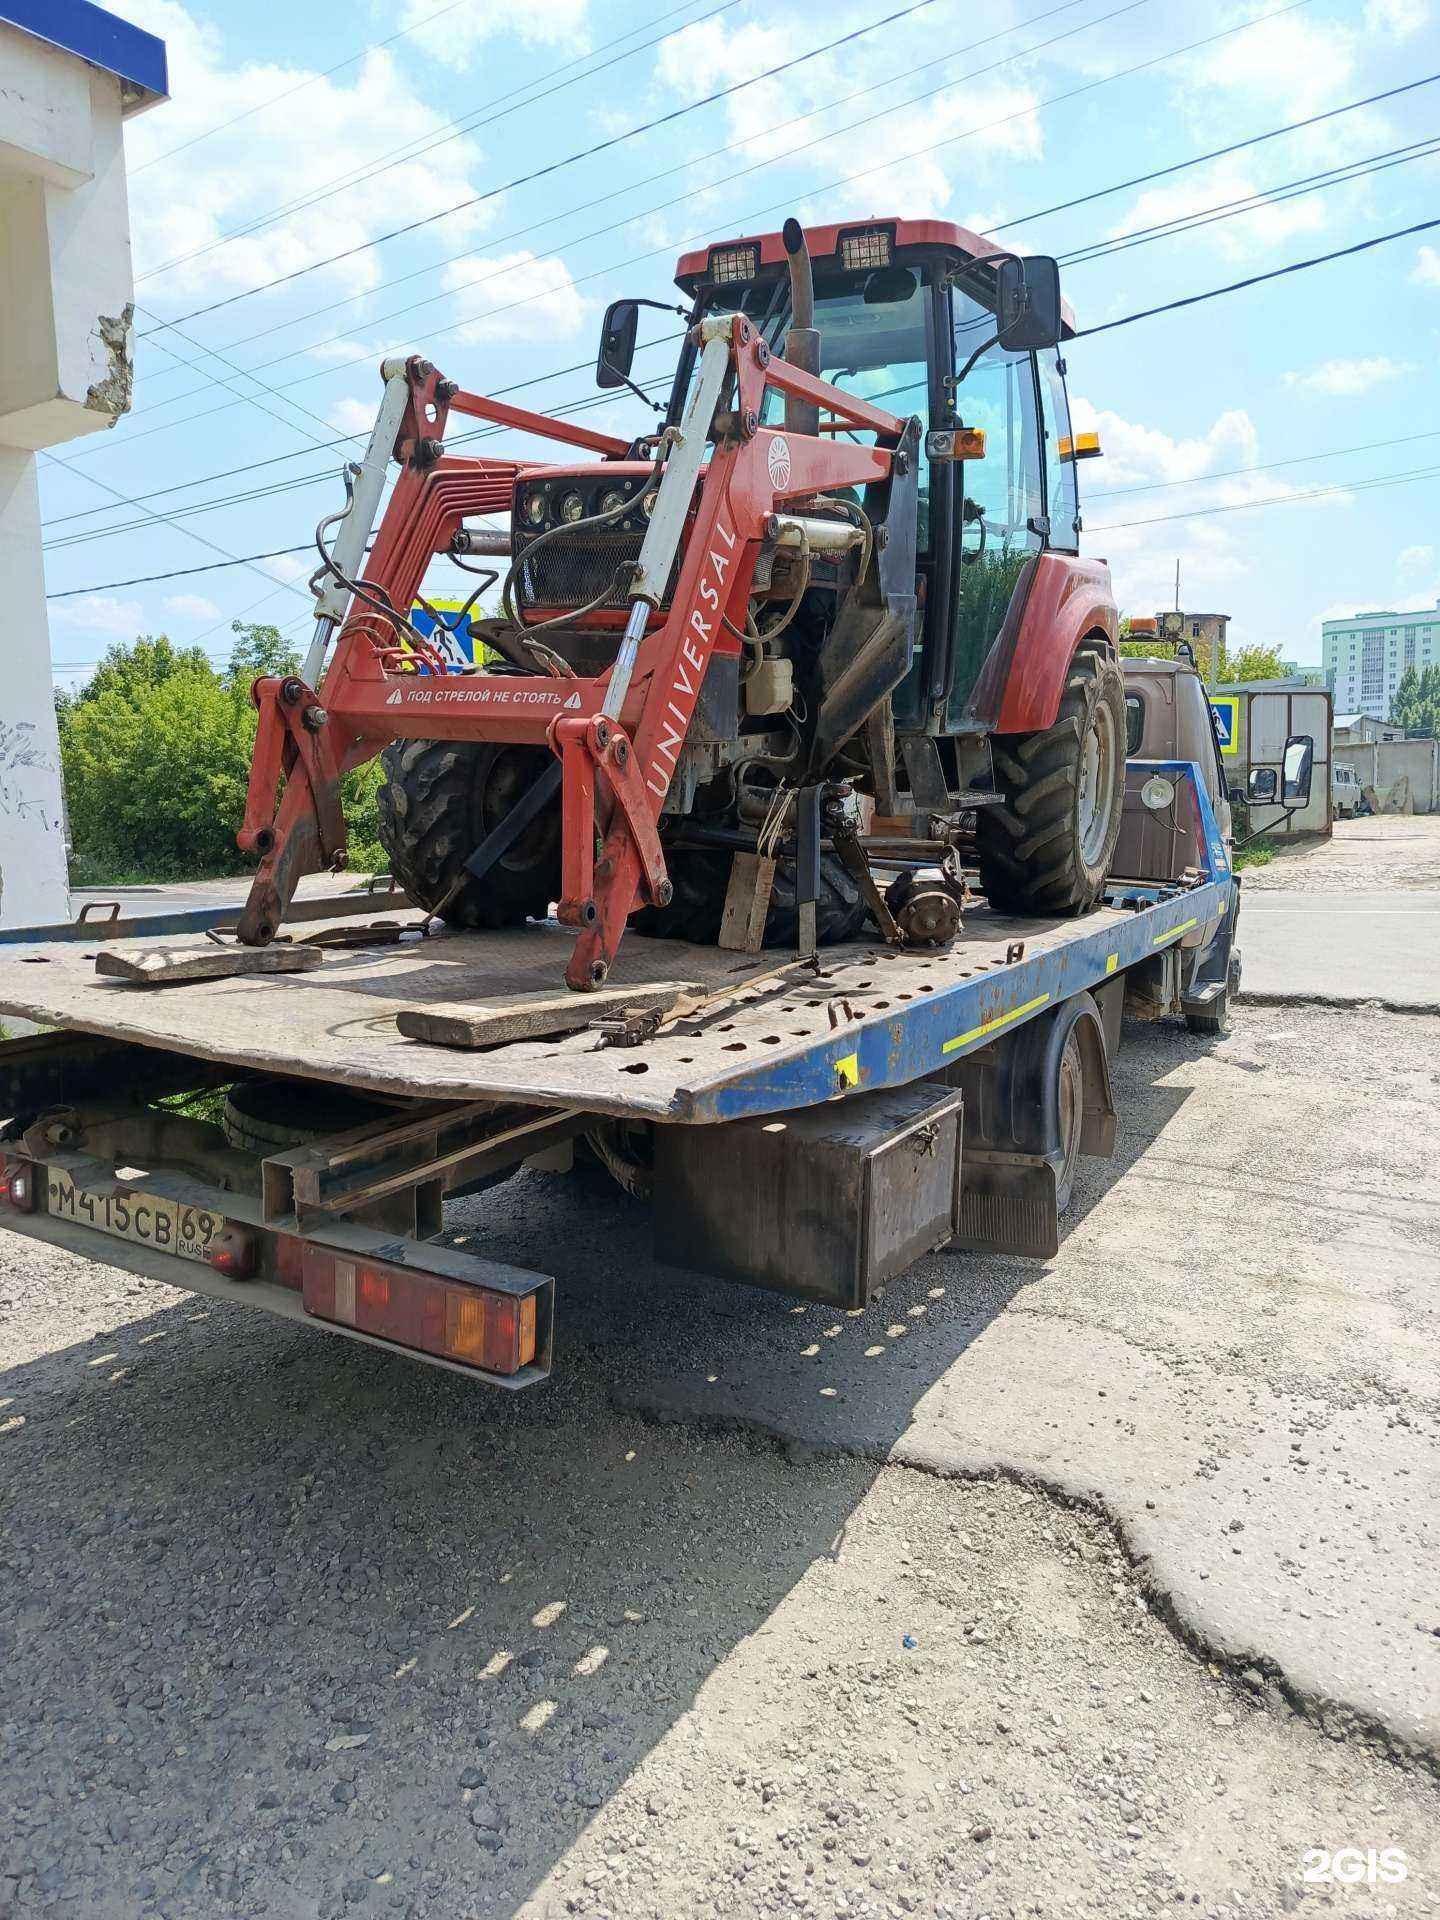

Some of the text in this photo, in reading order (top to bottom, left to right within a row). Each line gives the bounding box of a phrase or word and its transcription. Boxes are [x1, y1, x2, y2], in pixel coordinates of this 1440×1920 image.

[647, 522, 736, 798] UNIVERSAL
[407, 689, 561, 705] ПОД СТРЕЛОЙ НЕ СТОЯТЬ
[181, 1208, 214, 1245] 69
